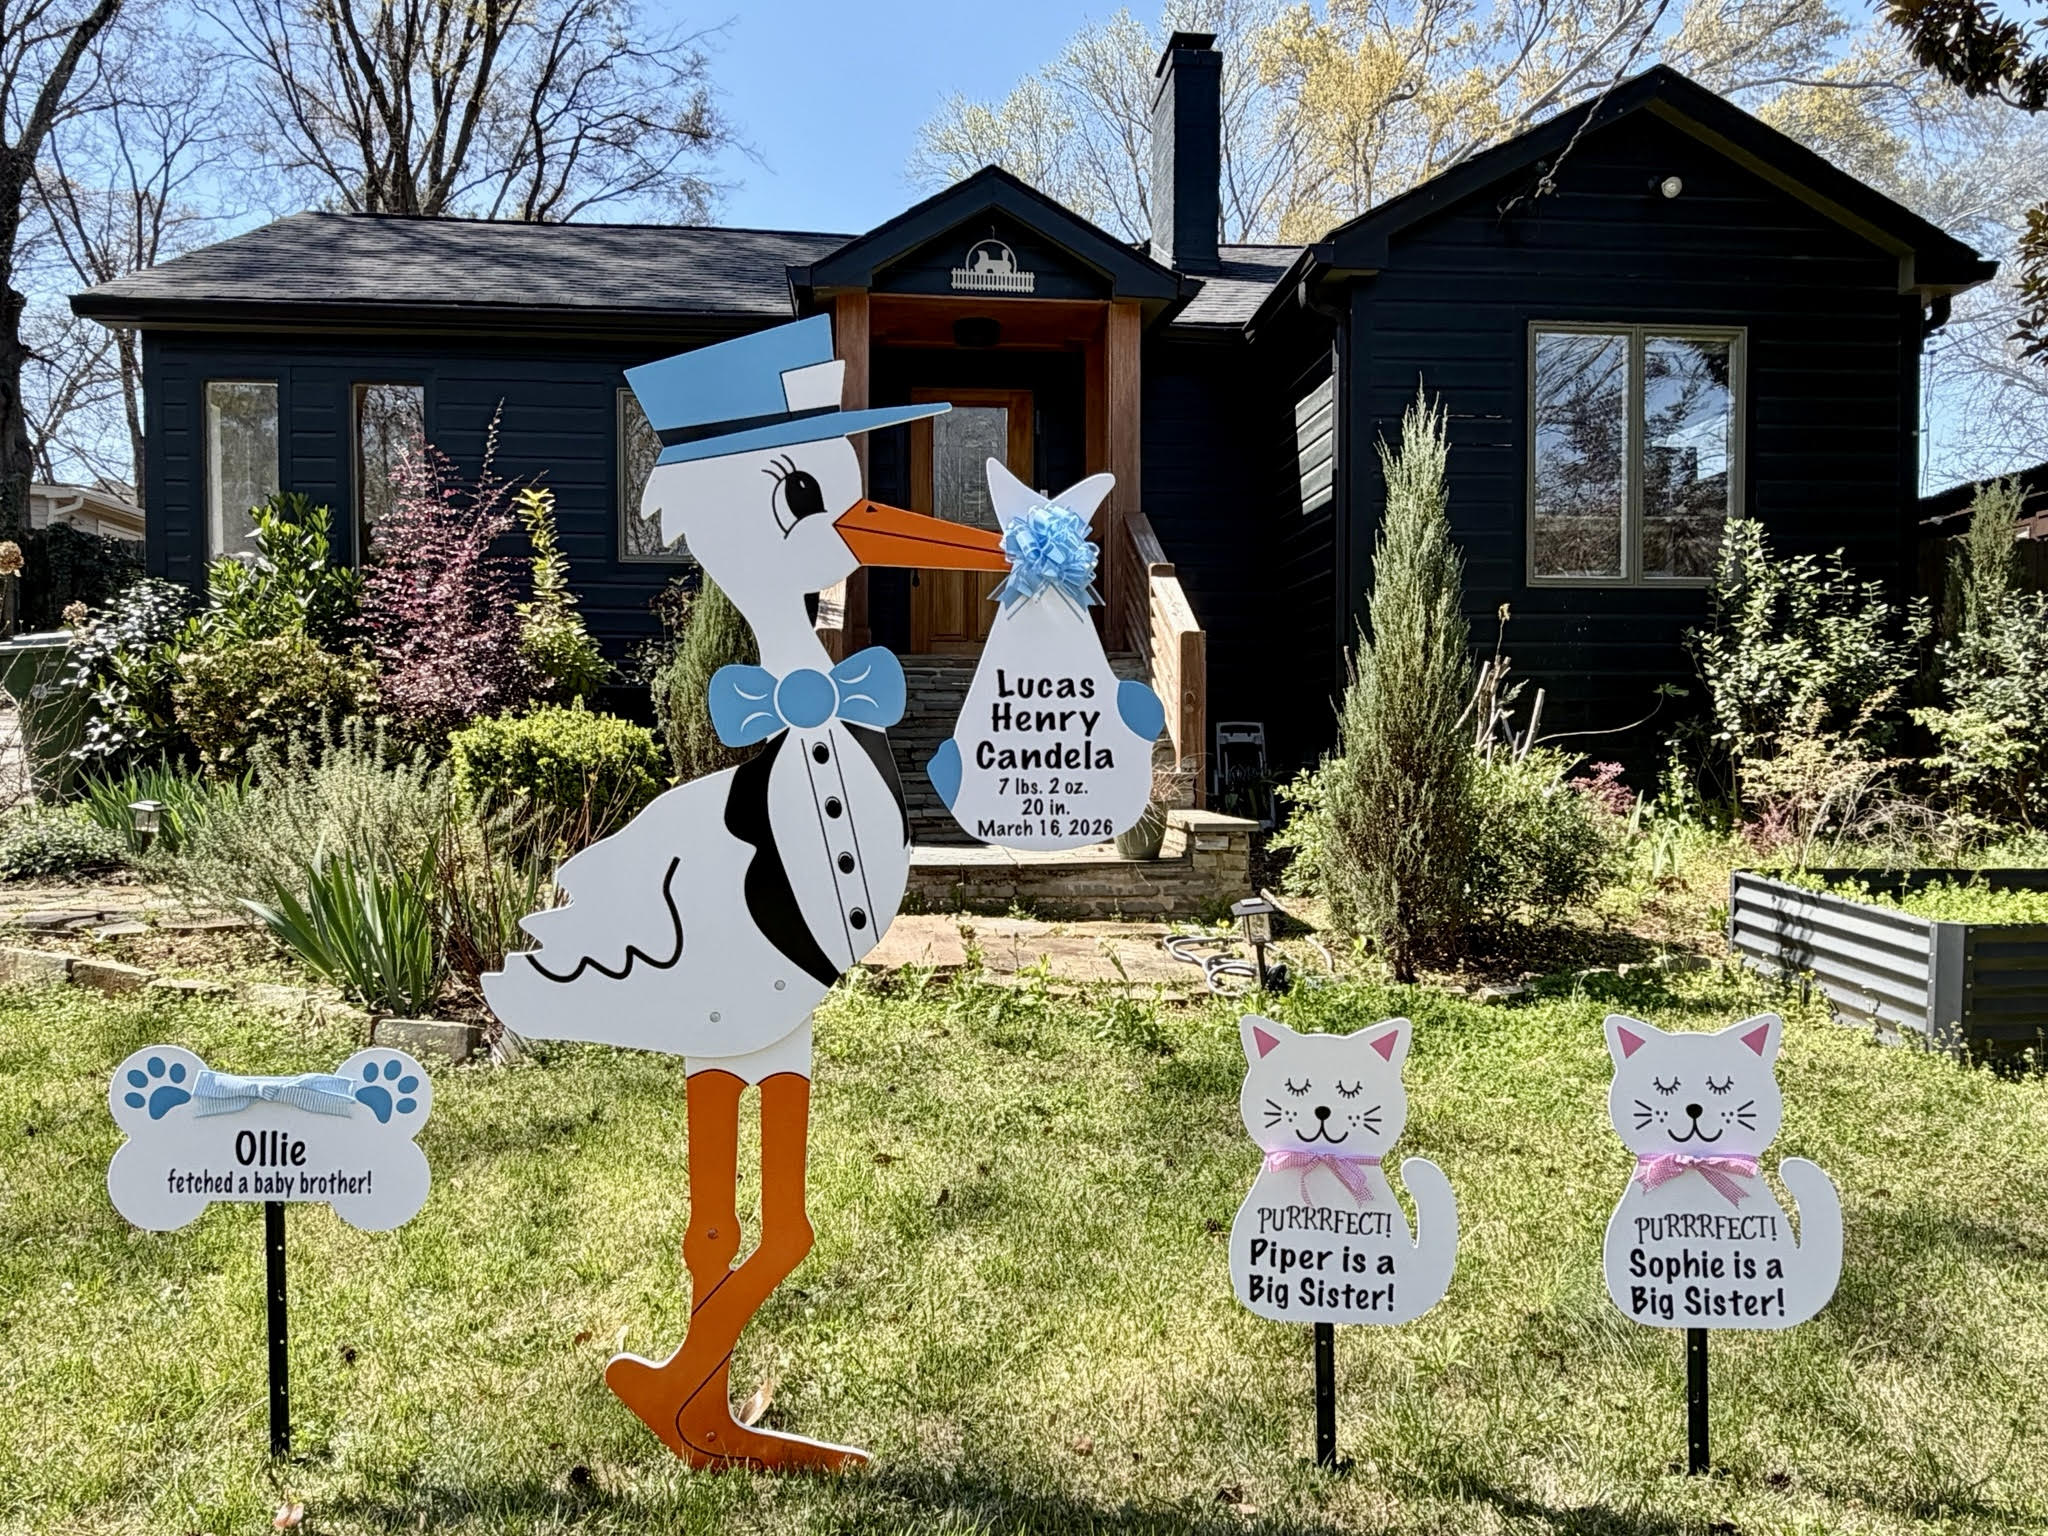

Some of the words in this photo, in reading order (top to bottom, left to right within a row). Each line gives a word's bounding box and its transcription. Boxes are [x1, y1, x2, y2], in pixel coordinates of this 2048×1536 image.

[997, 669, 1095, 699] Lucas
[992, 703, 1100, 736] Henry
[976, 741, 1114, 770] Candela
[998, 778, 1009, 794] 7
[1016, 778, 1043, 794] lbs.
[1049, 778, 1059, 794] 2
[1066, 782, 1088, 794] oz.
[1022, 799, 1043, 816] 20
[1050, 800, 1070, 816] in.
[978, 820, 1032, 837] March
[1040, 820, 1062, 838] 16,
[1069, 819, 1113, 836] 2026
[235, 1130, 307, 1166] Ollie
[168, 1169, 233, 1194] fetched
[239, 1176, 248, 1193] a
[254, 1171, 294, 1198] baby
[300, 1170, 372, 1194] brother!
[1257, 1206, 1392, 1237] PURRRFECT!
[1635, 1214, 1777, 1244] PURRRFECT!
[1250, 1238, 1333, 1273] Piper
[1343, 1246, 1366, 1273] is
[1377, 1255, 1395, 1274] a
[1629, 1248, 1725, 1284] Sophie
[1734, 1251, 1756, 1279] is
[1767, 1258, 1783, 1279] a
[1249, 1274, 1288, 1309] Big
[1299, 1277, 1394, 1311] Sister!
[1631, 1286, 1673, 1320] Big
[1684, 1286, 1784, 1316] Sister!
